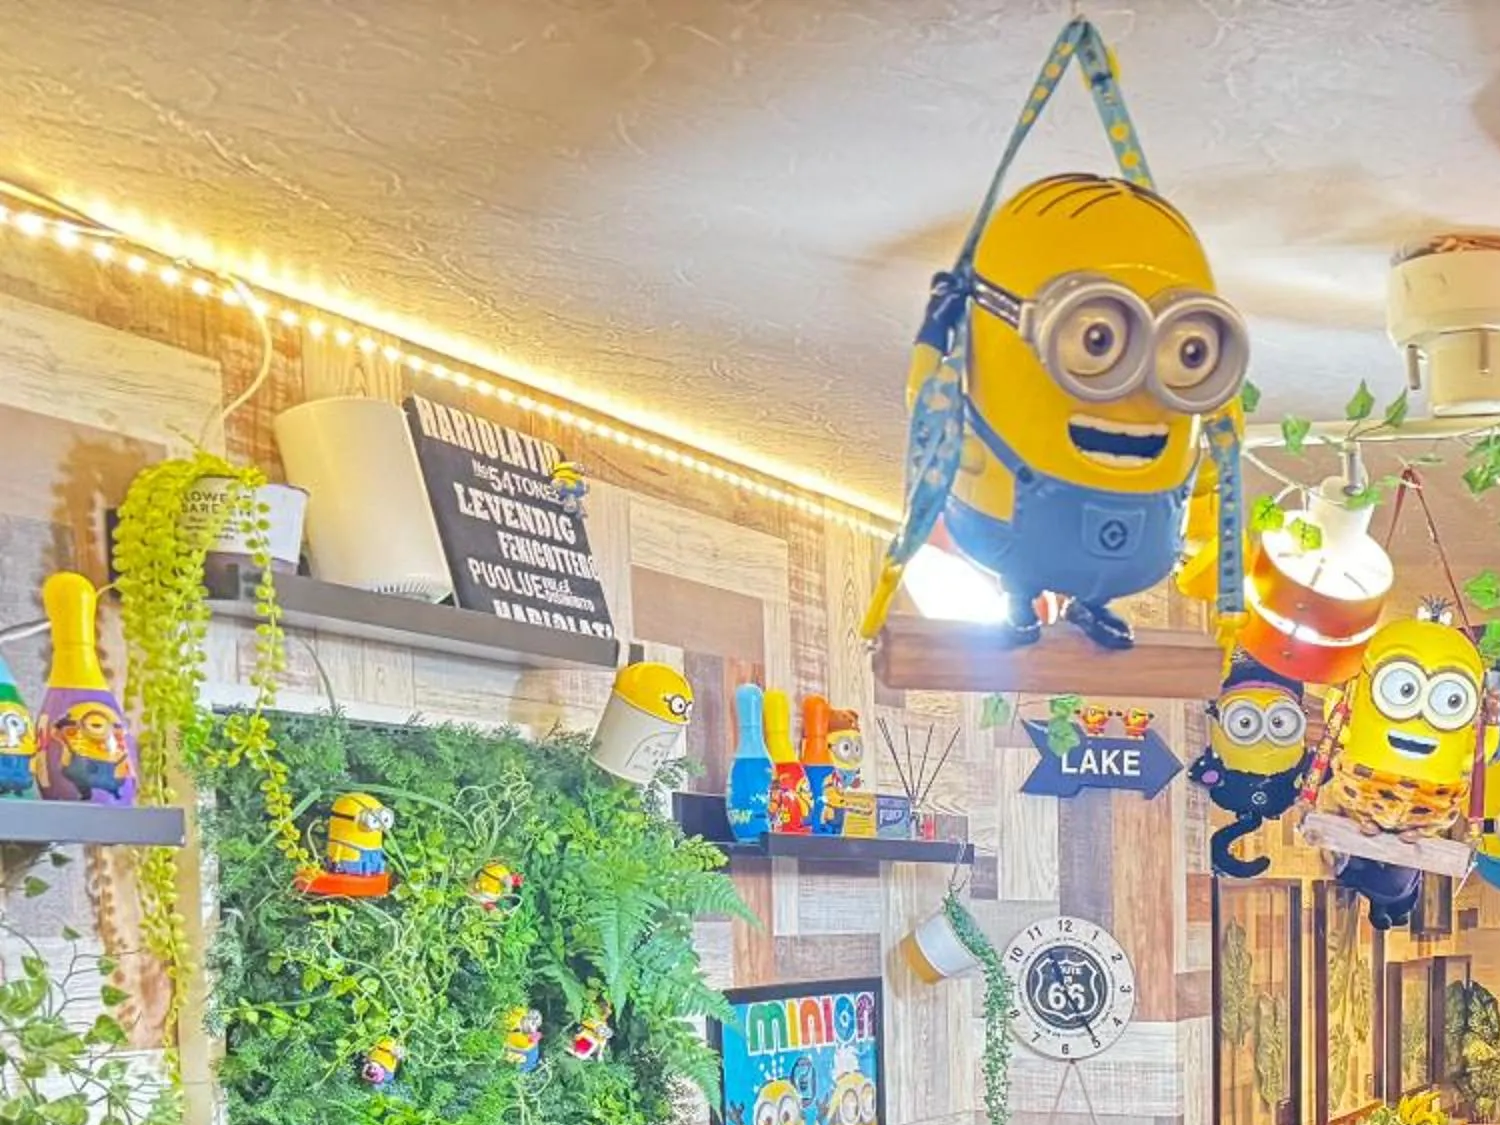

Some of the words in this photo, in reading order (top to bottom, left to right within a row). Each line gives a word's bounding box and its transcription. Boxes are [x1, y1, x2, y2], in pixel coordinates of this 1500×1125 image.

[453, 481, 577, 545] LEVENDIG
[1061, 748, 1141, 776] LAKE
[1058, 920, 1073, 933] 12
[1027, 925, 1043, 941] 11
[1091, 929, 1100, 941] 1
[1009, 947, 1024, 963] 10
[1111, 952, 1123, 964] 2
[1119, 984, 1132, 994] 3
[1112, 1016, 1123, 1027] 4
[1031, 1031, 1042, 1043] 7
[1061, 1043, 1070, 1055] 6
